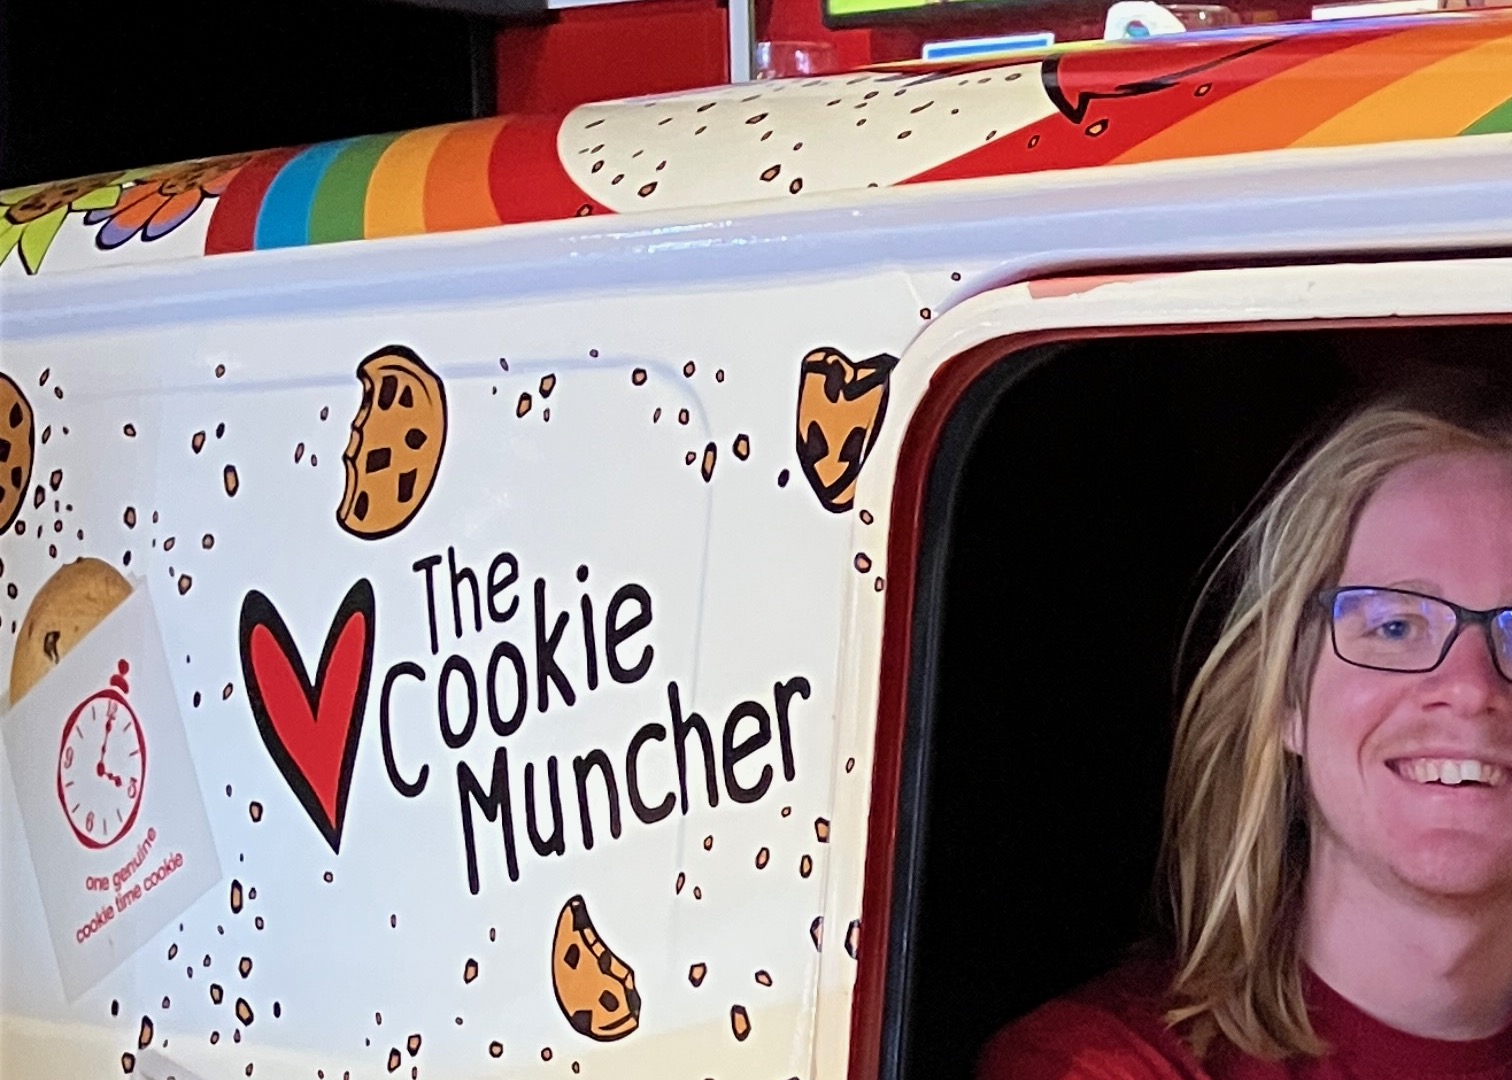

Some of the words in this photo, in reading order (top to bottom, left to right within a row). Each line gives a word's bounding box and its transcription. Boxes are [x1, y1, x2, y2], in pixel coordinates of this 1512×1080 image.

[412, 545, 520, 655] The
[379, 563, 655, 799] Cookie
[456, 675, 812, 896] Muncher
[76, 903, 116, 944] cookie
[114, 883, 142, 913] time
[143, 852, 184, 892] cookie
[86, 876, 110, 892] one
[112, 827, 157, 892] genuine
